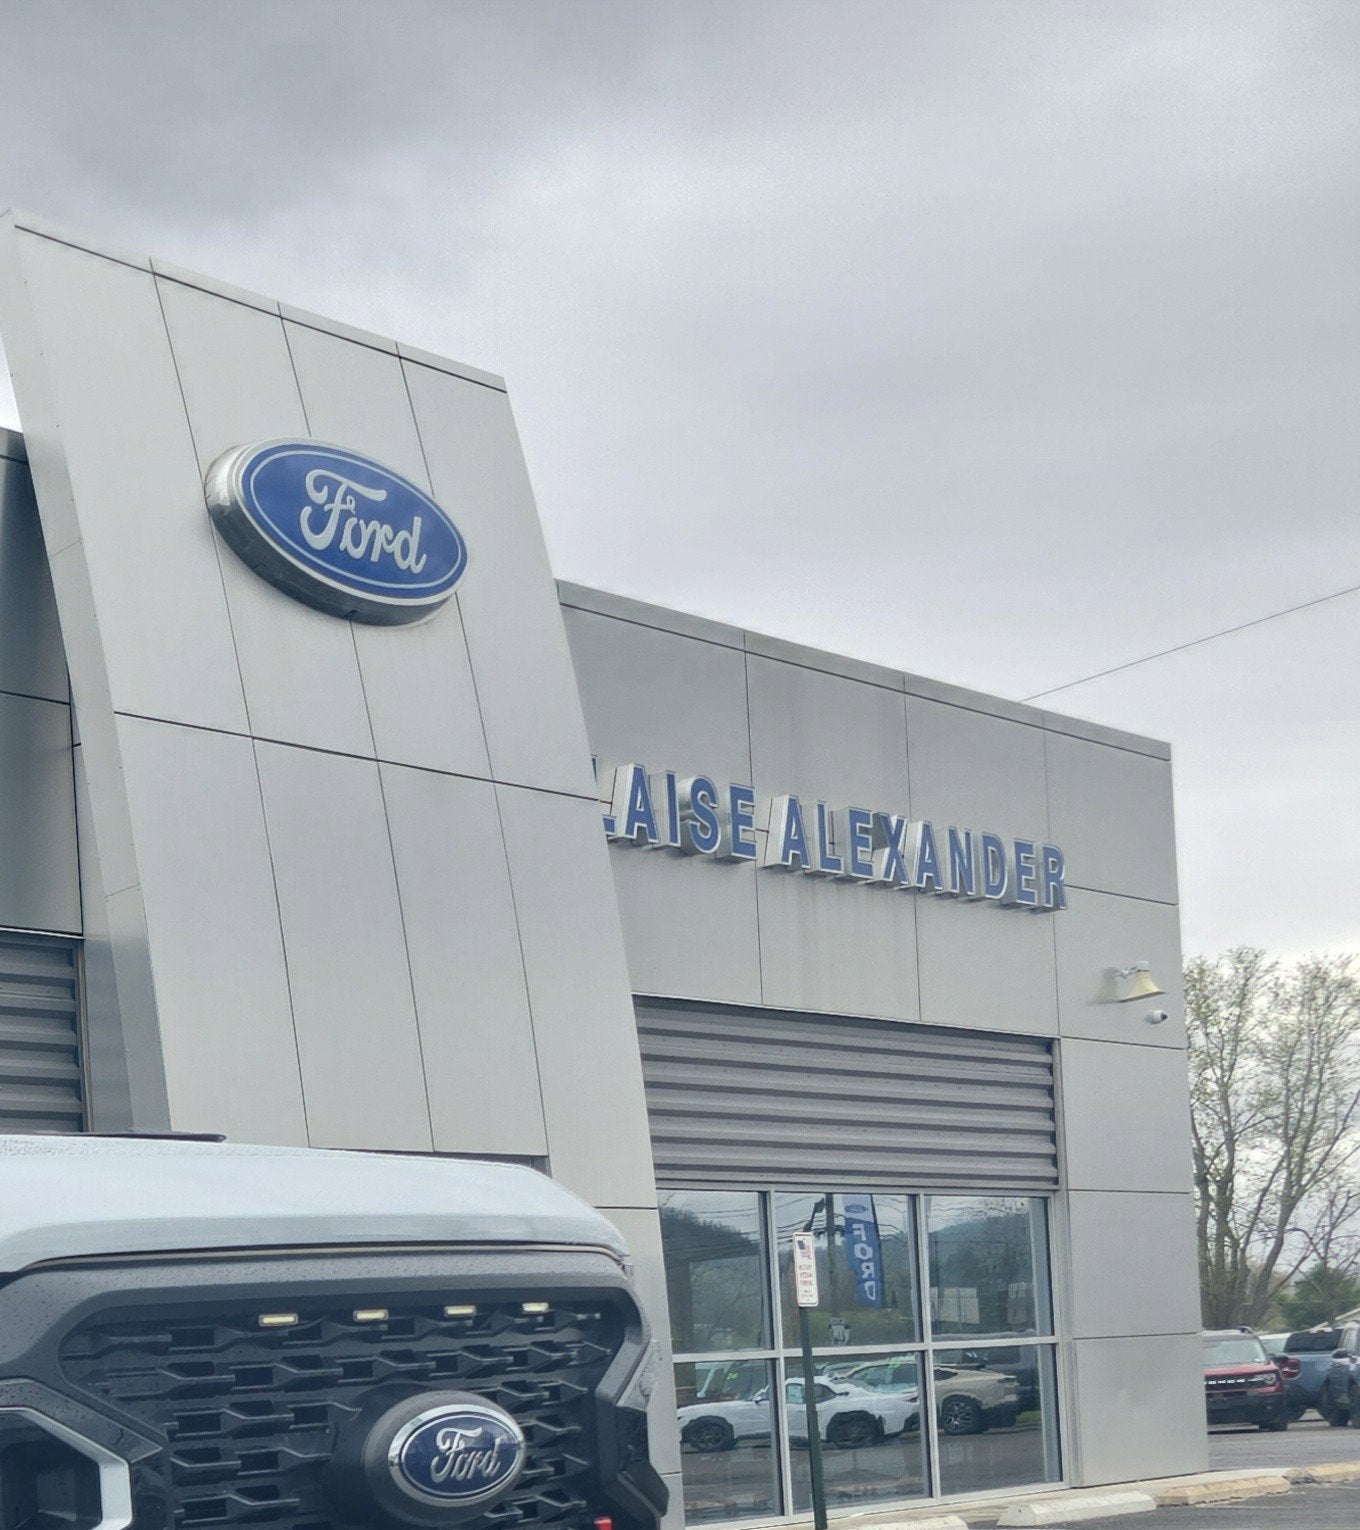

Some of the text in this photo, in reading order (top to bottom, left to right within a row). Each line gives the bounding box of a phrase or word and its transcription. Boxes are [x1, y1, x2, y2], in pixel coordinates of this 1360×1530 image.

[300, 469, 427, 574] Ford
[591, 754, 1067, 910] AISE ALEXANDER
[430, 1427, 501, 1483] Ford
